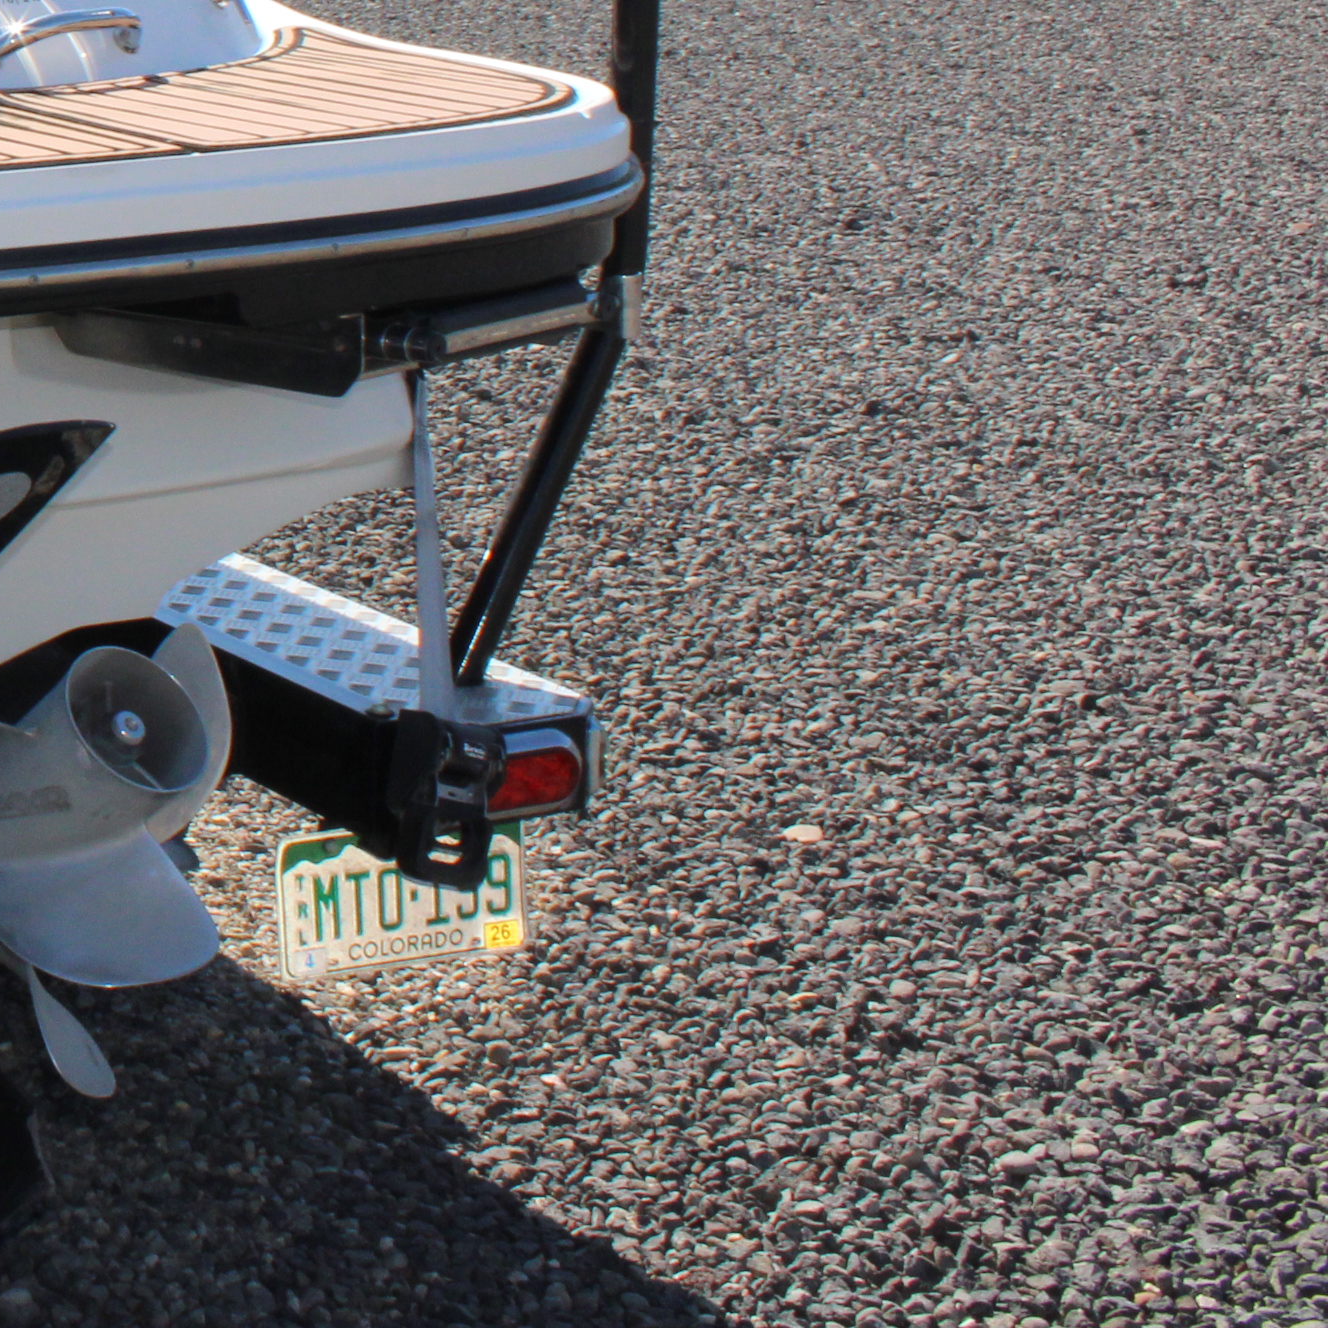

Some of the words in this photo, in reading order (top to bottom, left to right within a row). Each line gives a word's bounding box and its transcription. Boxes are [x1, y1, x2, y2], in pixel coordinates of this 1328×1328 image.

[490, 924, 512, 942] 26
[348, 928, 464, 961] COLORADO
[304, 952, 315, 969] 4
